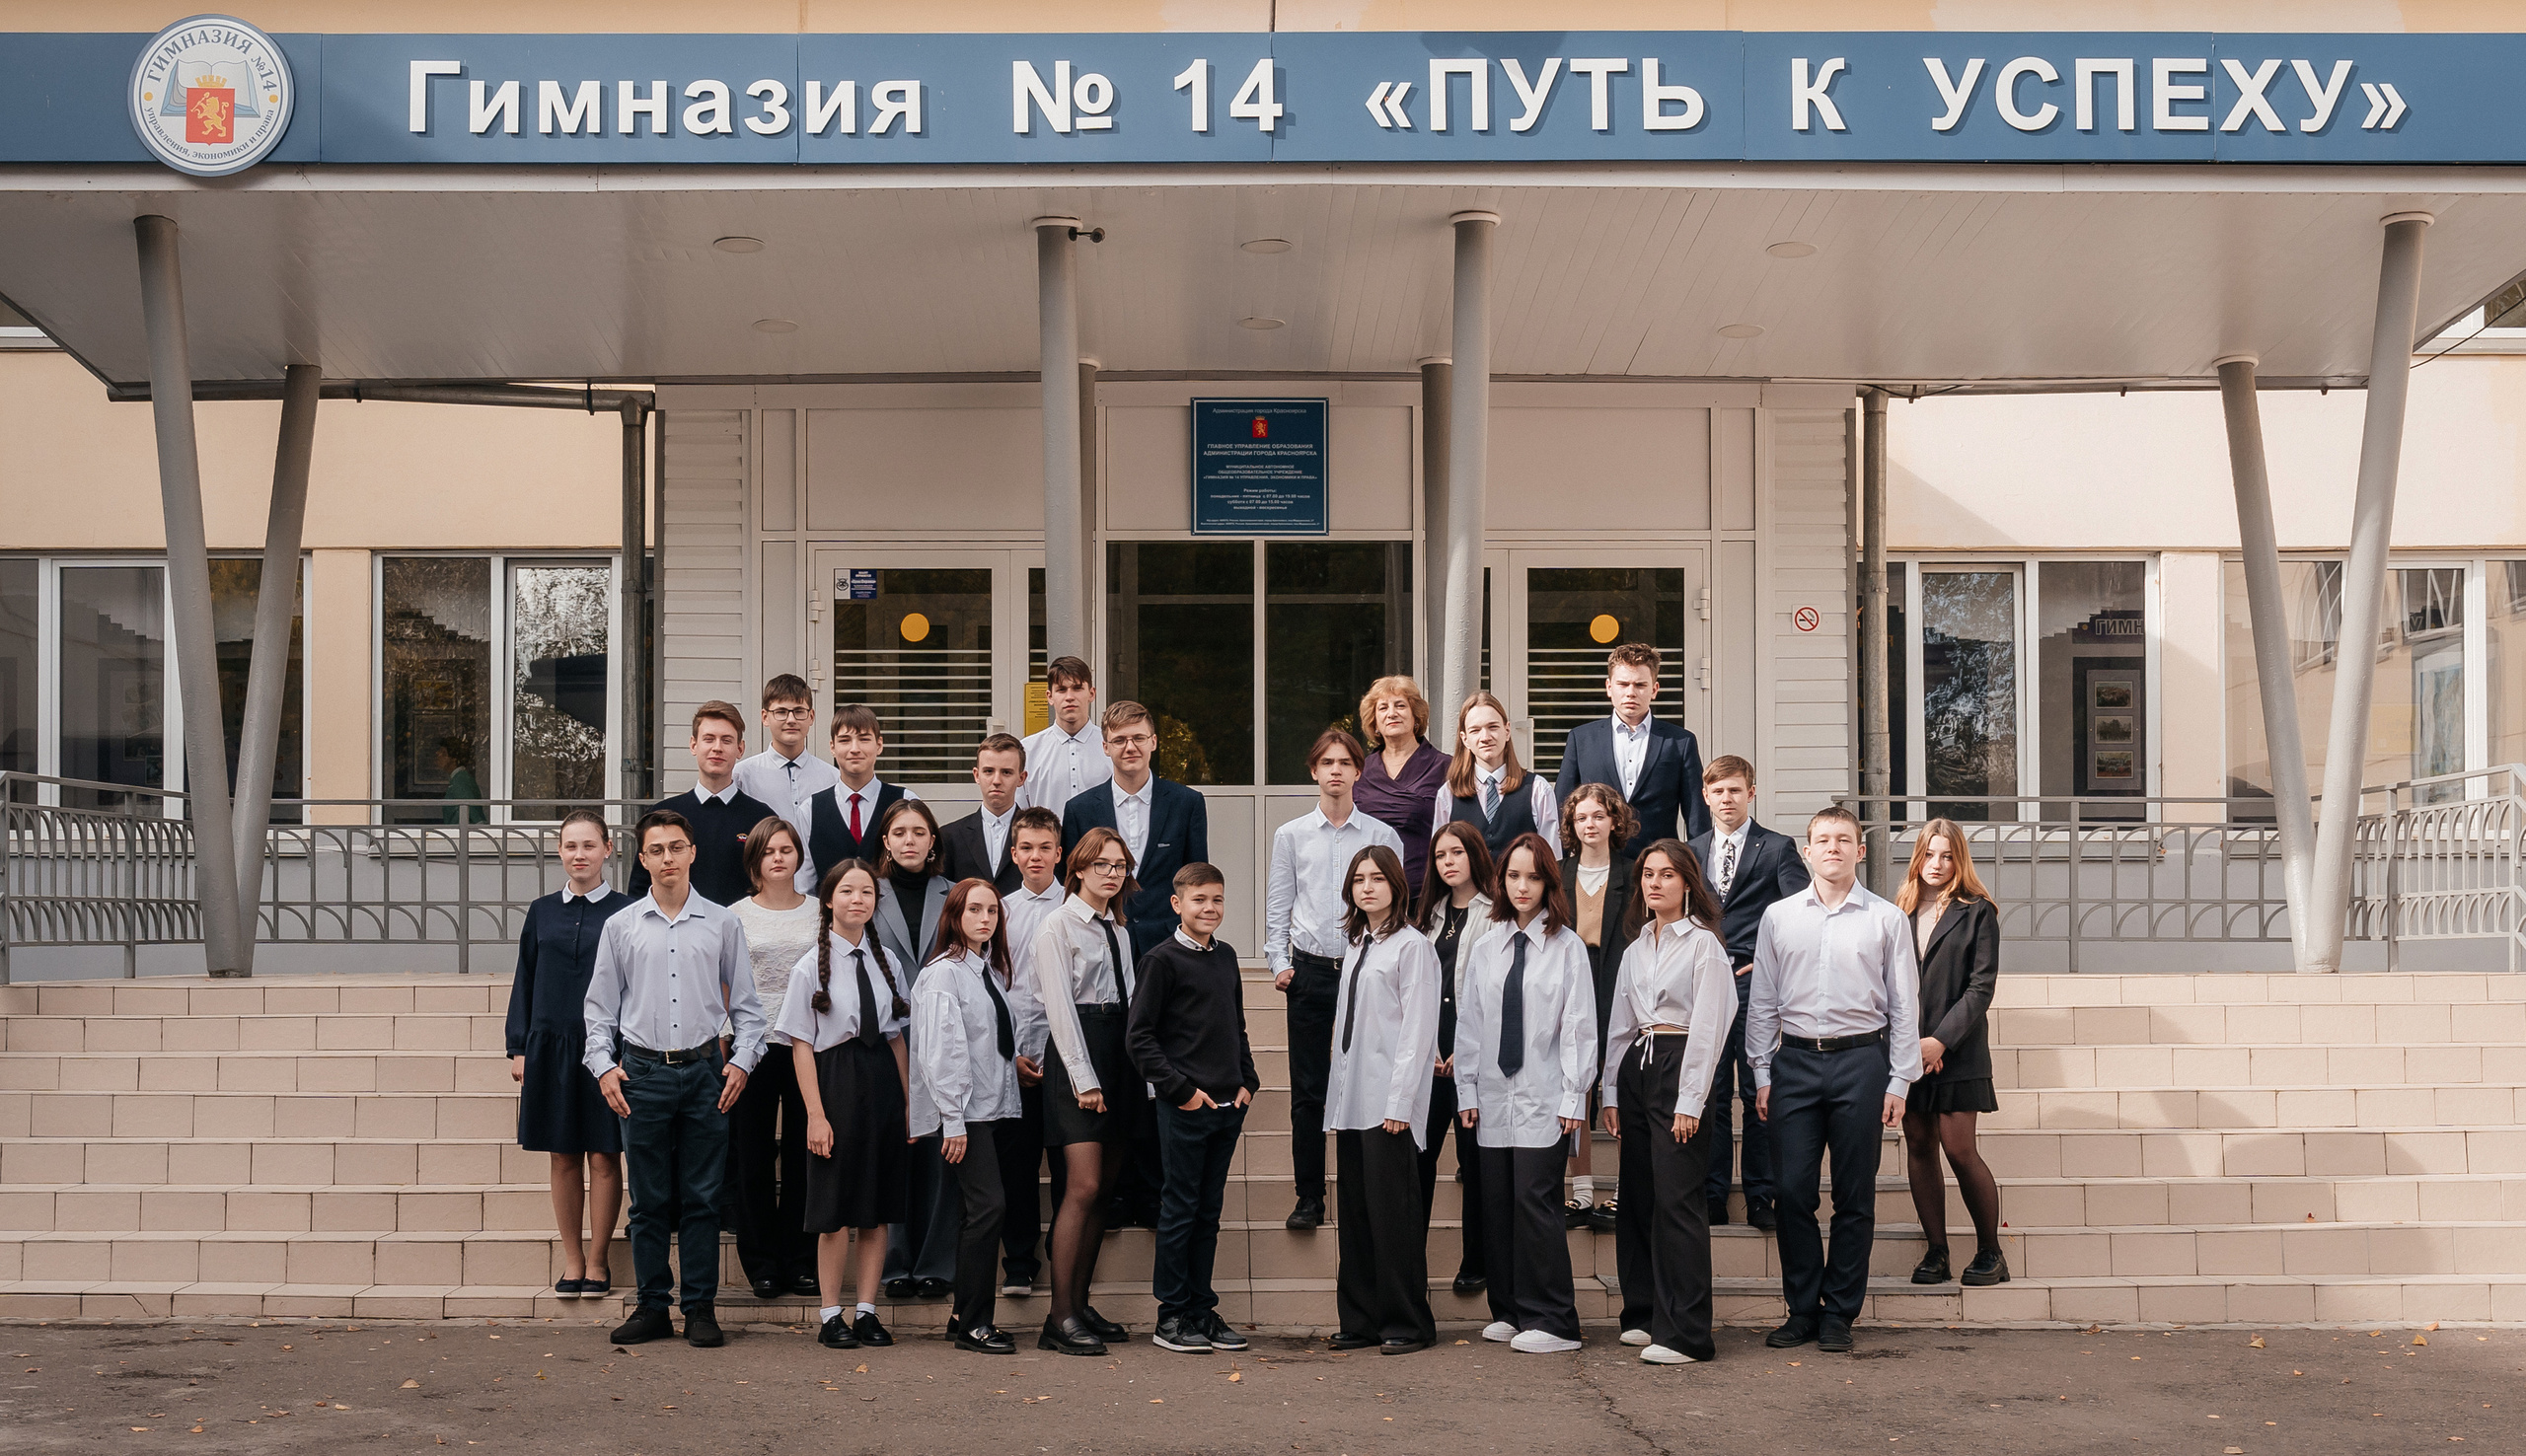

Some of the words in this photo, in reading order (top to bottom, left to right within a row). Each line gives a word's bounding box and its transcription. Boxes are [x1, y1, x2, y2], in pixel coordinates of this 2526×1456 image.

[147, 29, 254, 83] ГИМНАЗИЯ
[251, 55, 277, 92] №14
[409, 60, 921, 134] Гимназия
[1012, 60, 1114, 133] №
[1174, 58, 1283, 132] 14
[1365, 57, 1704, 131] «ПУТЬ
[1791, 57, 1847, 130] К
[1922, 56, 2408, 132] УСПЕХУ»
[144, 107, 190, 157] управления,
[191, 141, 250, 160] экономики
[249, 135, 258, 144] и
[255, 109, 274, 138] права
